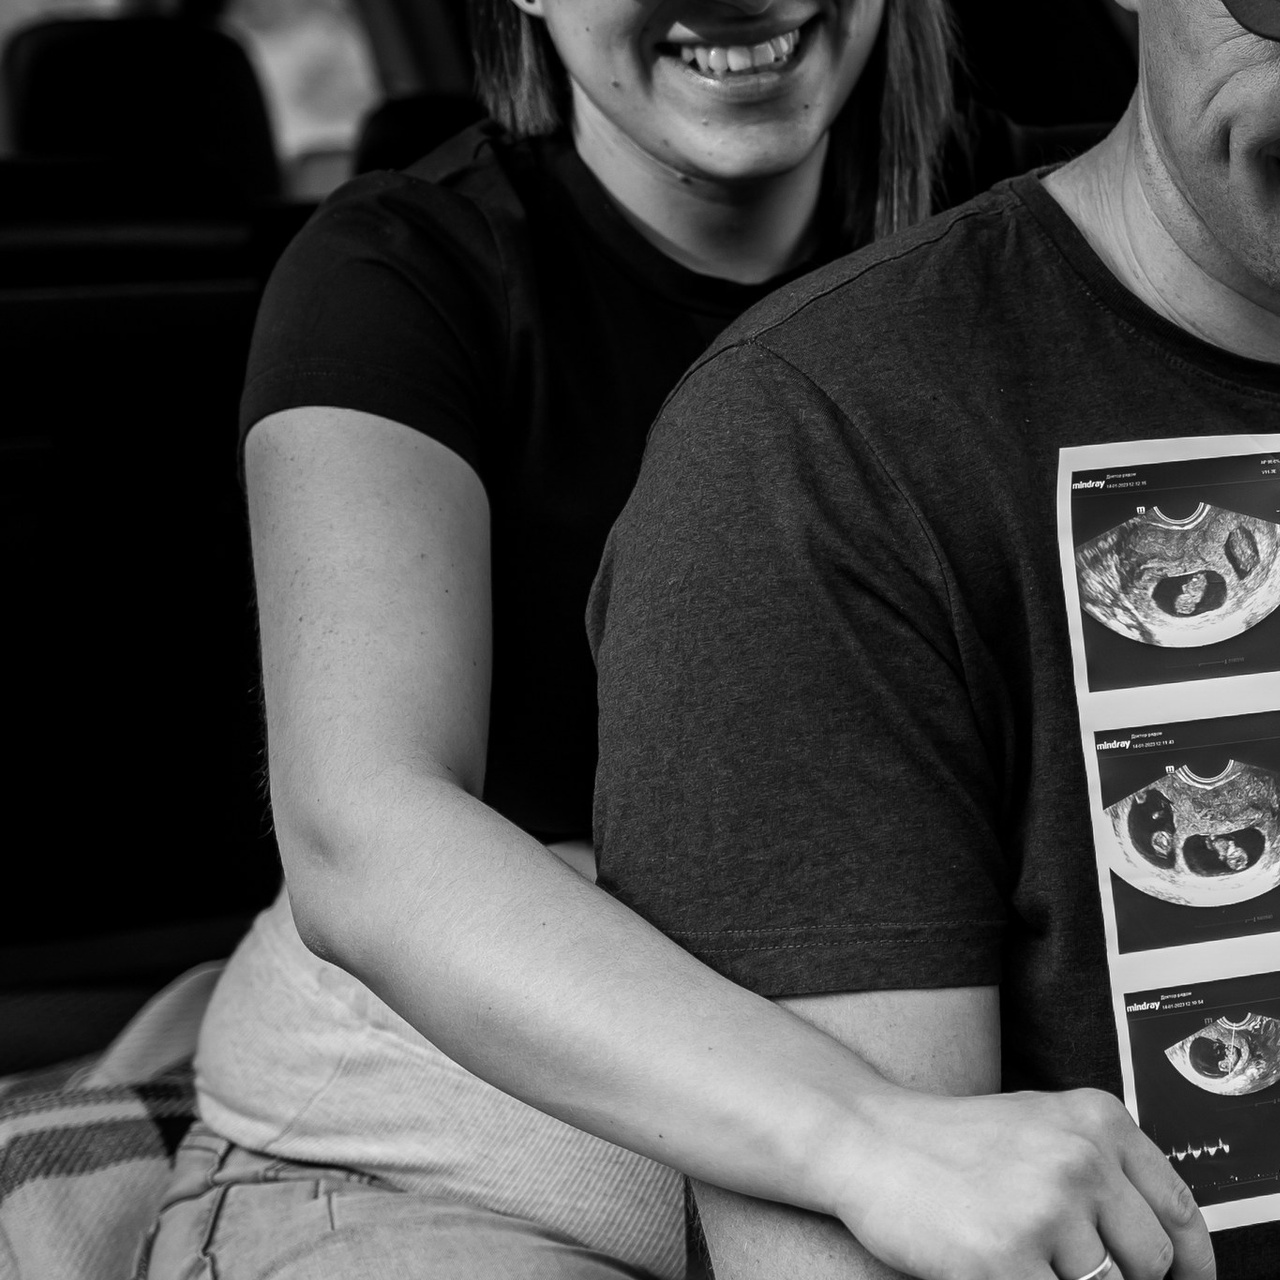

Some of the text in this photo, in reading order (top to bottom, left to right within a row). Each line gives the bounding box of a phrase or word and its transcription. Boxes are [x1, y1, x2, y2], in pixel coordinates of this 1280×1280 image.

[1072, 480, 1105, 489] mindray
[1096, 739, 1131, 750] mindray
[1126, 1001, 1160, 1013] mindray
